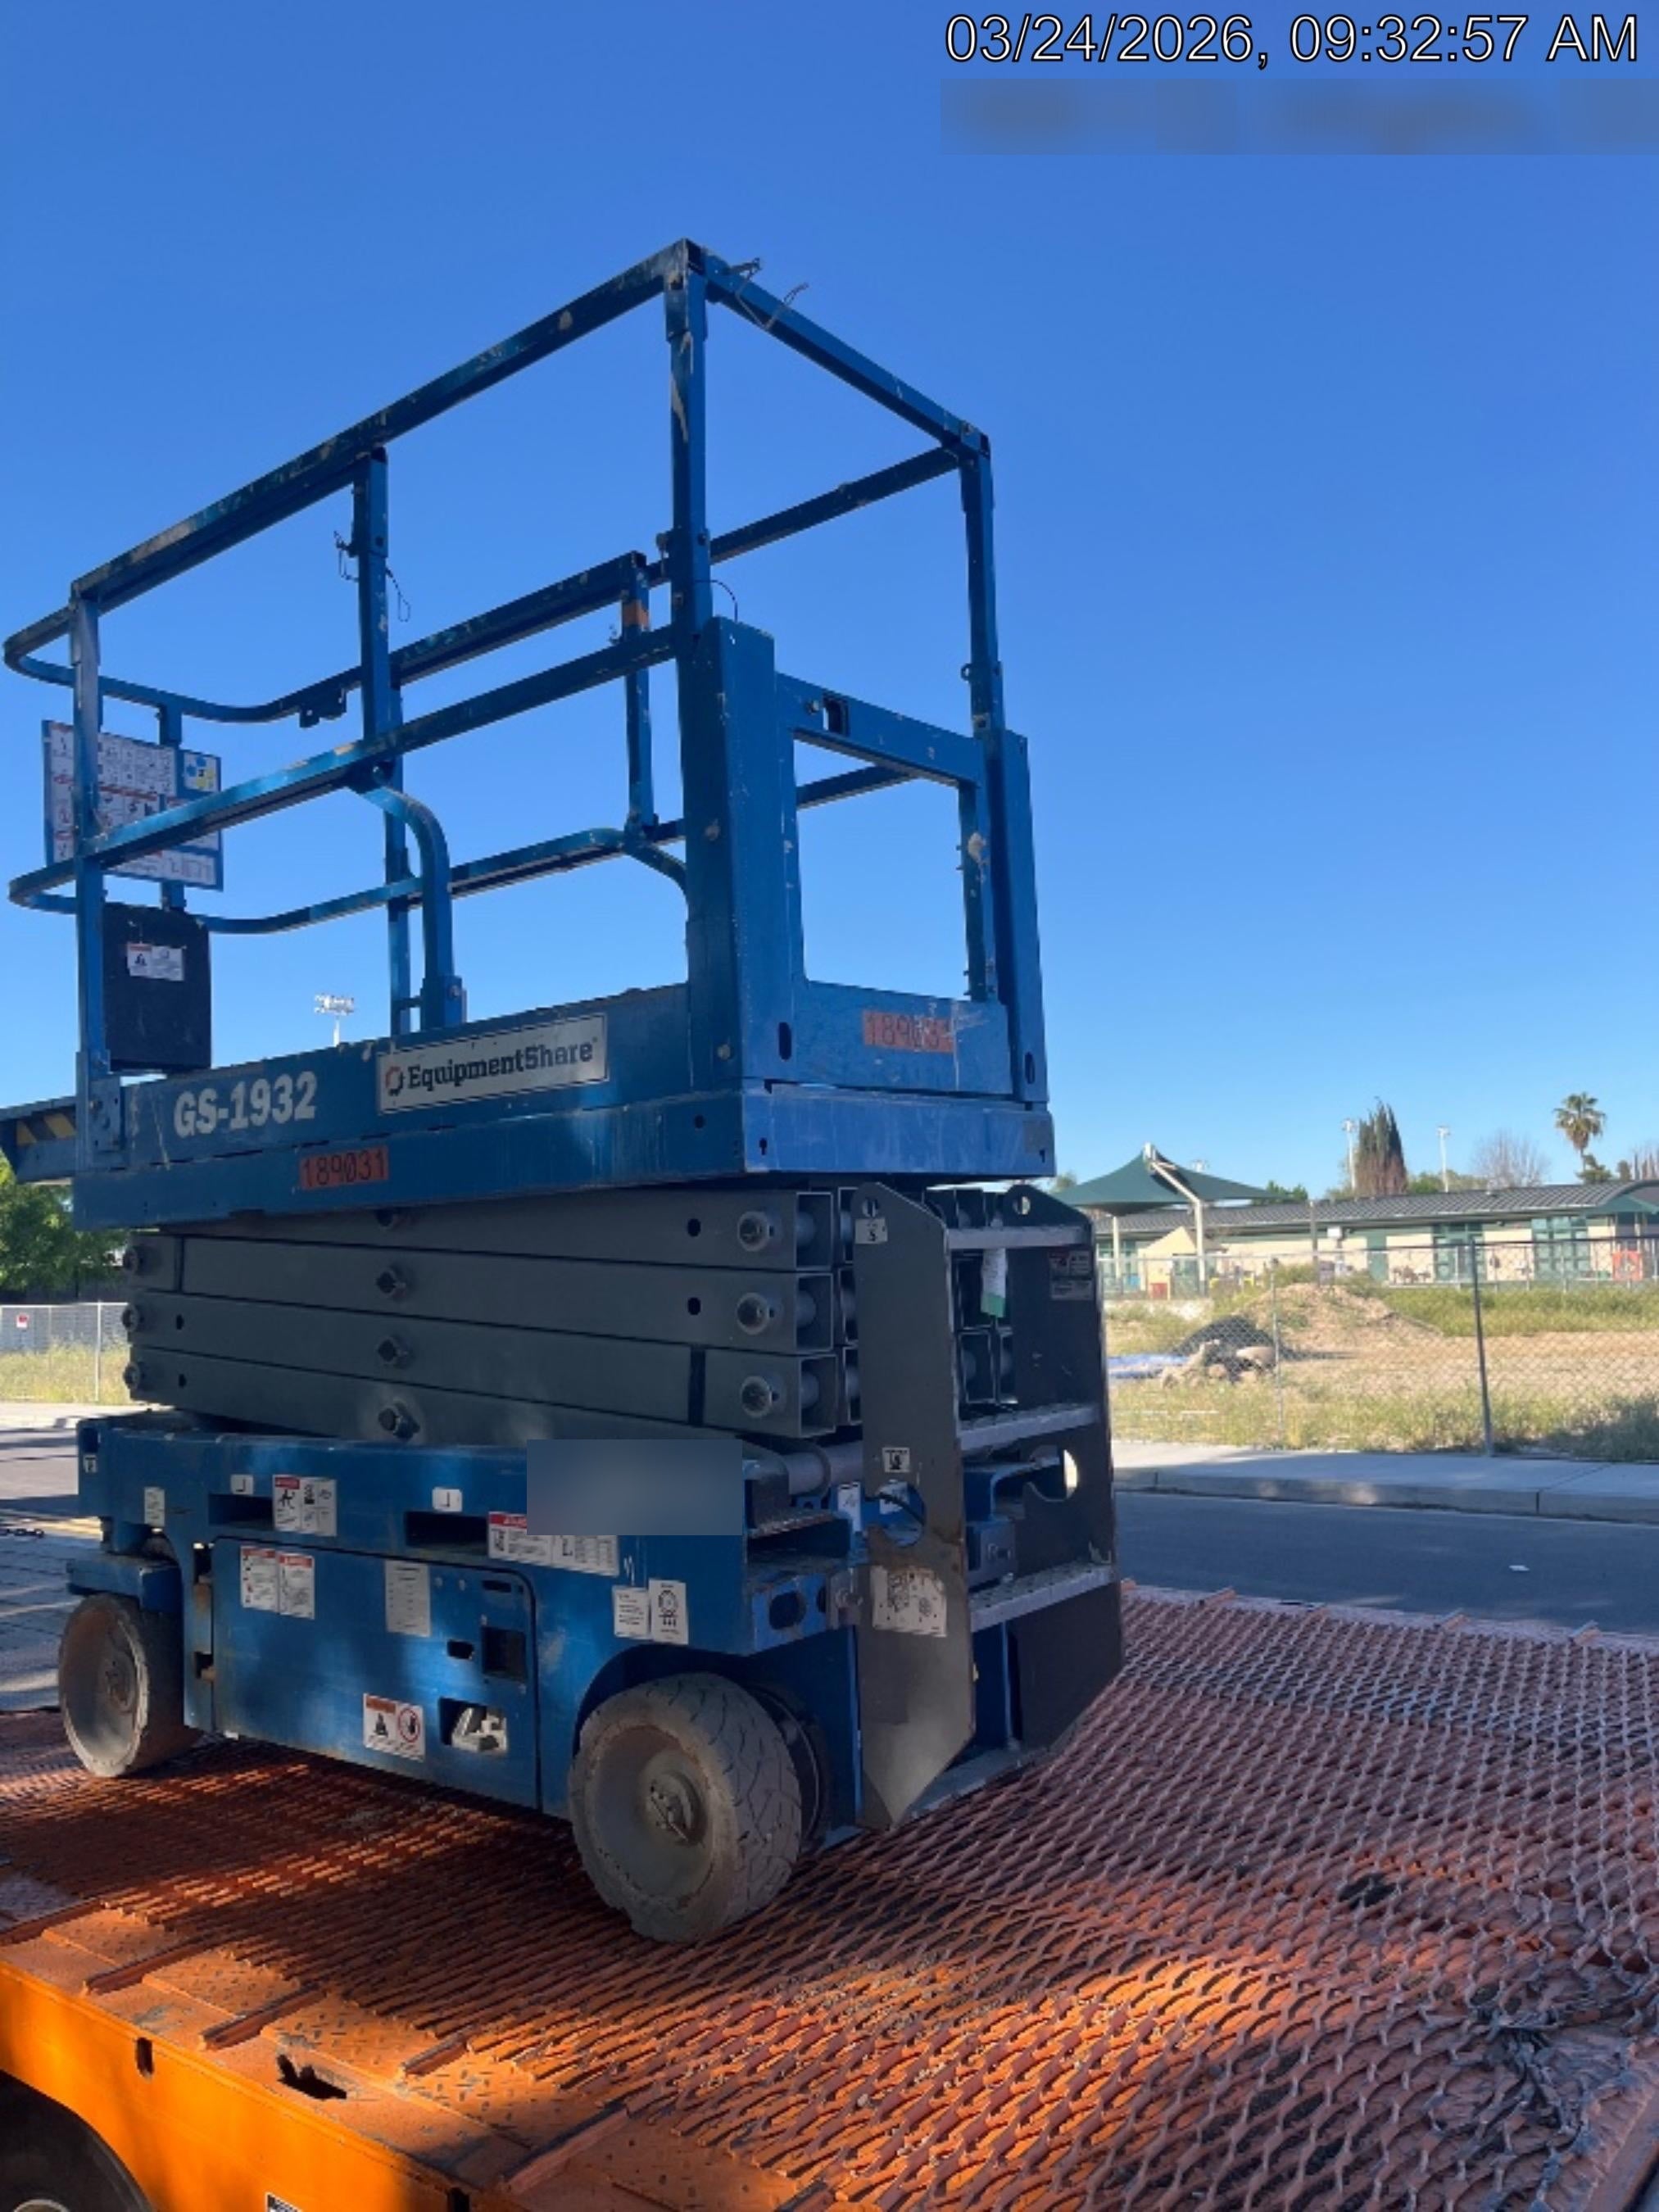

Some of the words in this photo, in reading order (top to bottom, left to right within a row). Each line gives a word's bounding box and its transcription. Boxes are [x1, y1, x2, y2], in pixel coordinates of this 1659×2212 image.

[408, 1040, 593, 1091] EquipmentShare
[174, 1071, 317, 1138] GS-1932
[305, 1149, 384, 1187] 189031
